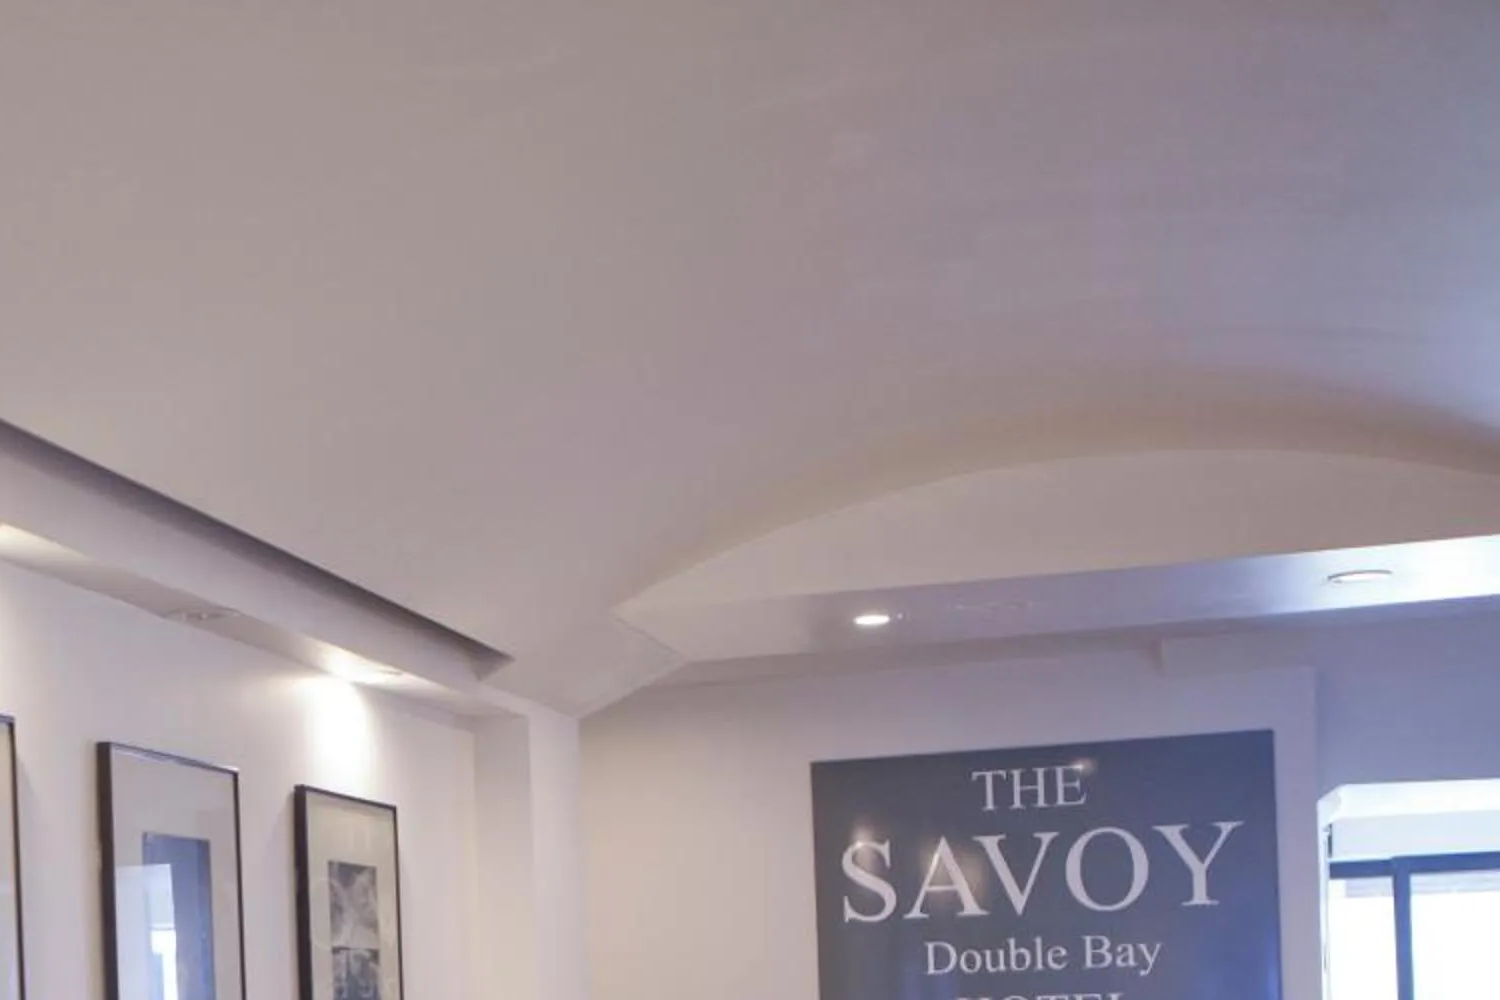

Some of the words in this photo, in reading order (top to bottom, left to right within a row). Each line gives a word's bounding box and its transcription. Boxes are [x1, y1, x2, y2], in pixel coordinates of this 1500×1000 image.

[971, 765, 1087, 811] THE
[841, 820, 1245, 923] SAVOY
[925, 936, 1068, 976] Double
[1082, 934, 1163, 976] Bay
